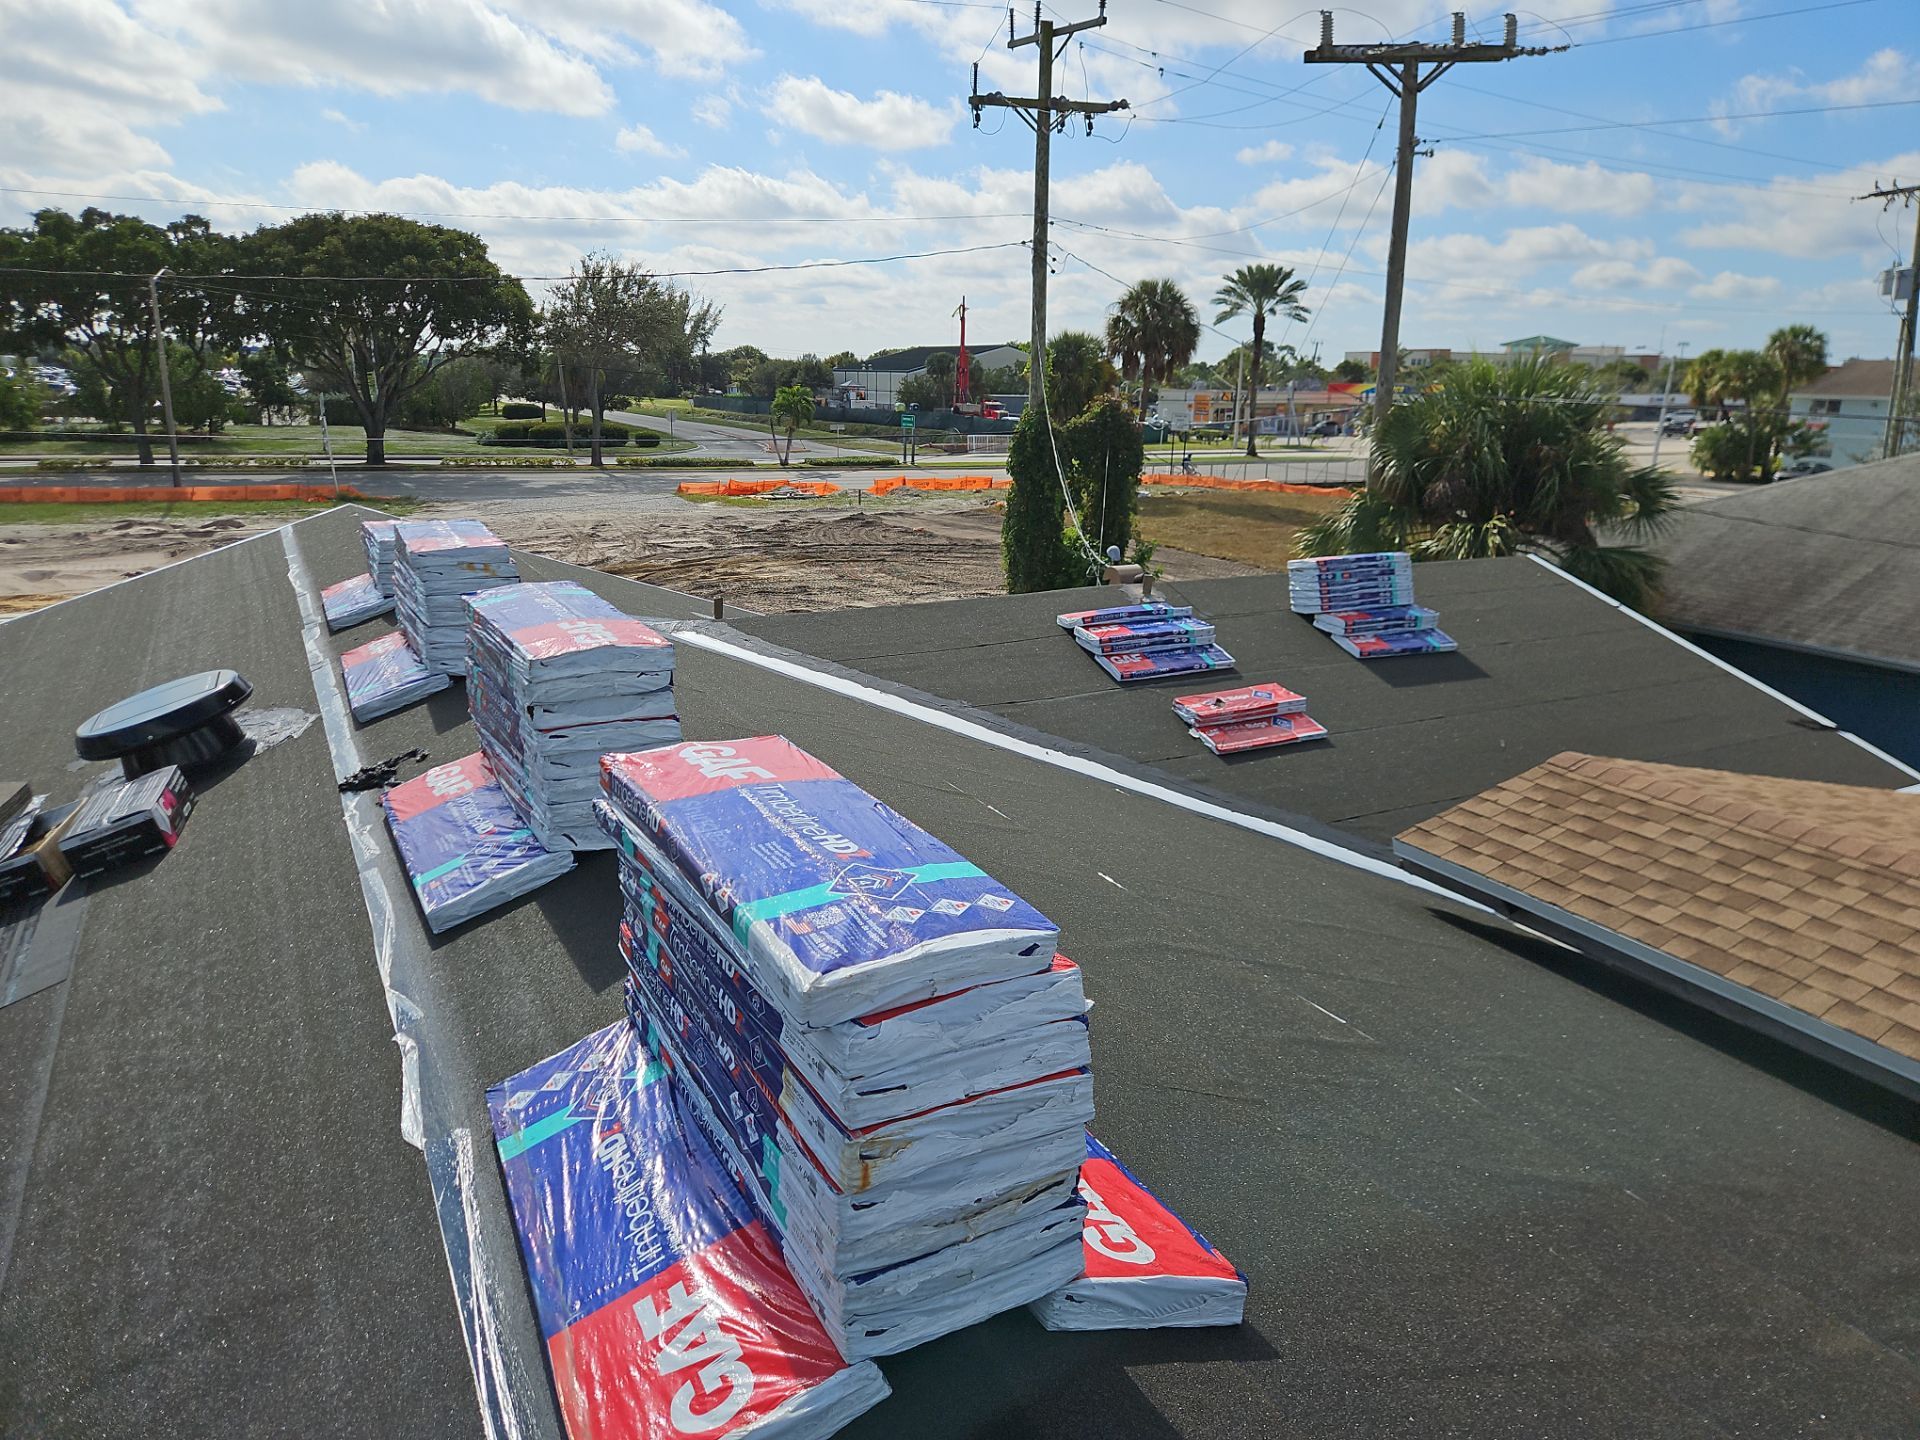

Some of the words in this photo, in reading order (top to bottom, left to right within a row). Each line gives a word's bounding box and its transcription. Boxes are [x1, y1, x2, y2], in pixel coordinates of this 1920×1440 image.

[1111, 654, 1143, 665] GAF
[679, 744, 776, 780] GAF
[426, 764, 475, 797] GAF
[1078, 1179, 1155, 1264] GA
[632, 1279, 756, 1434] GAF
